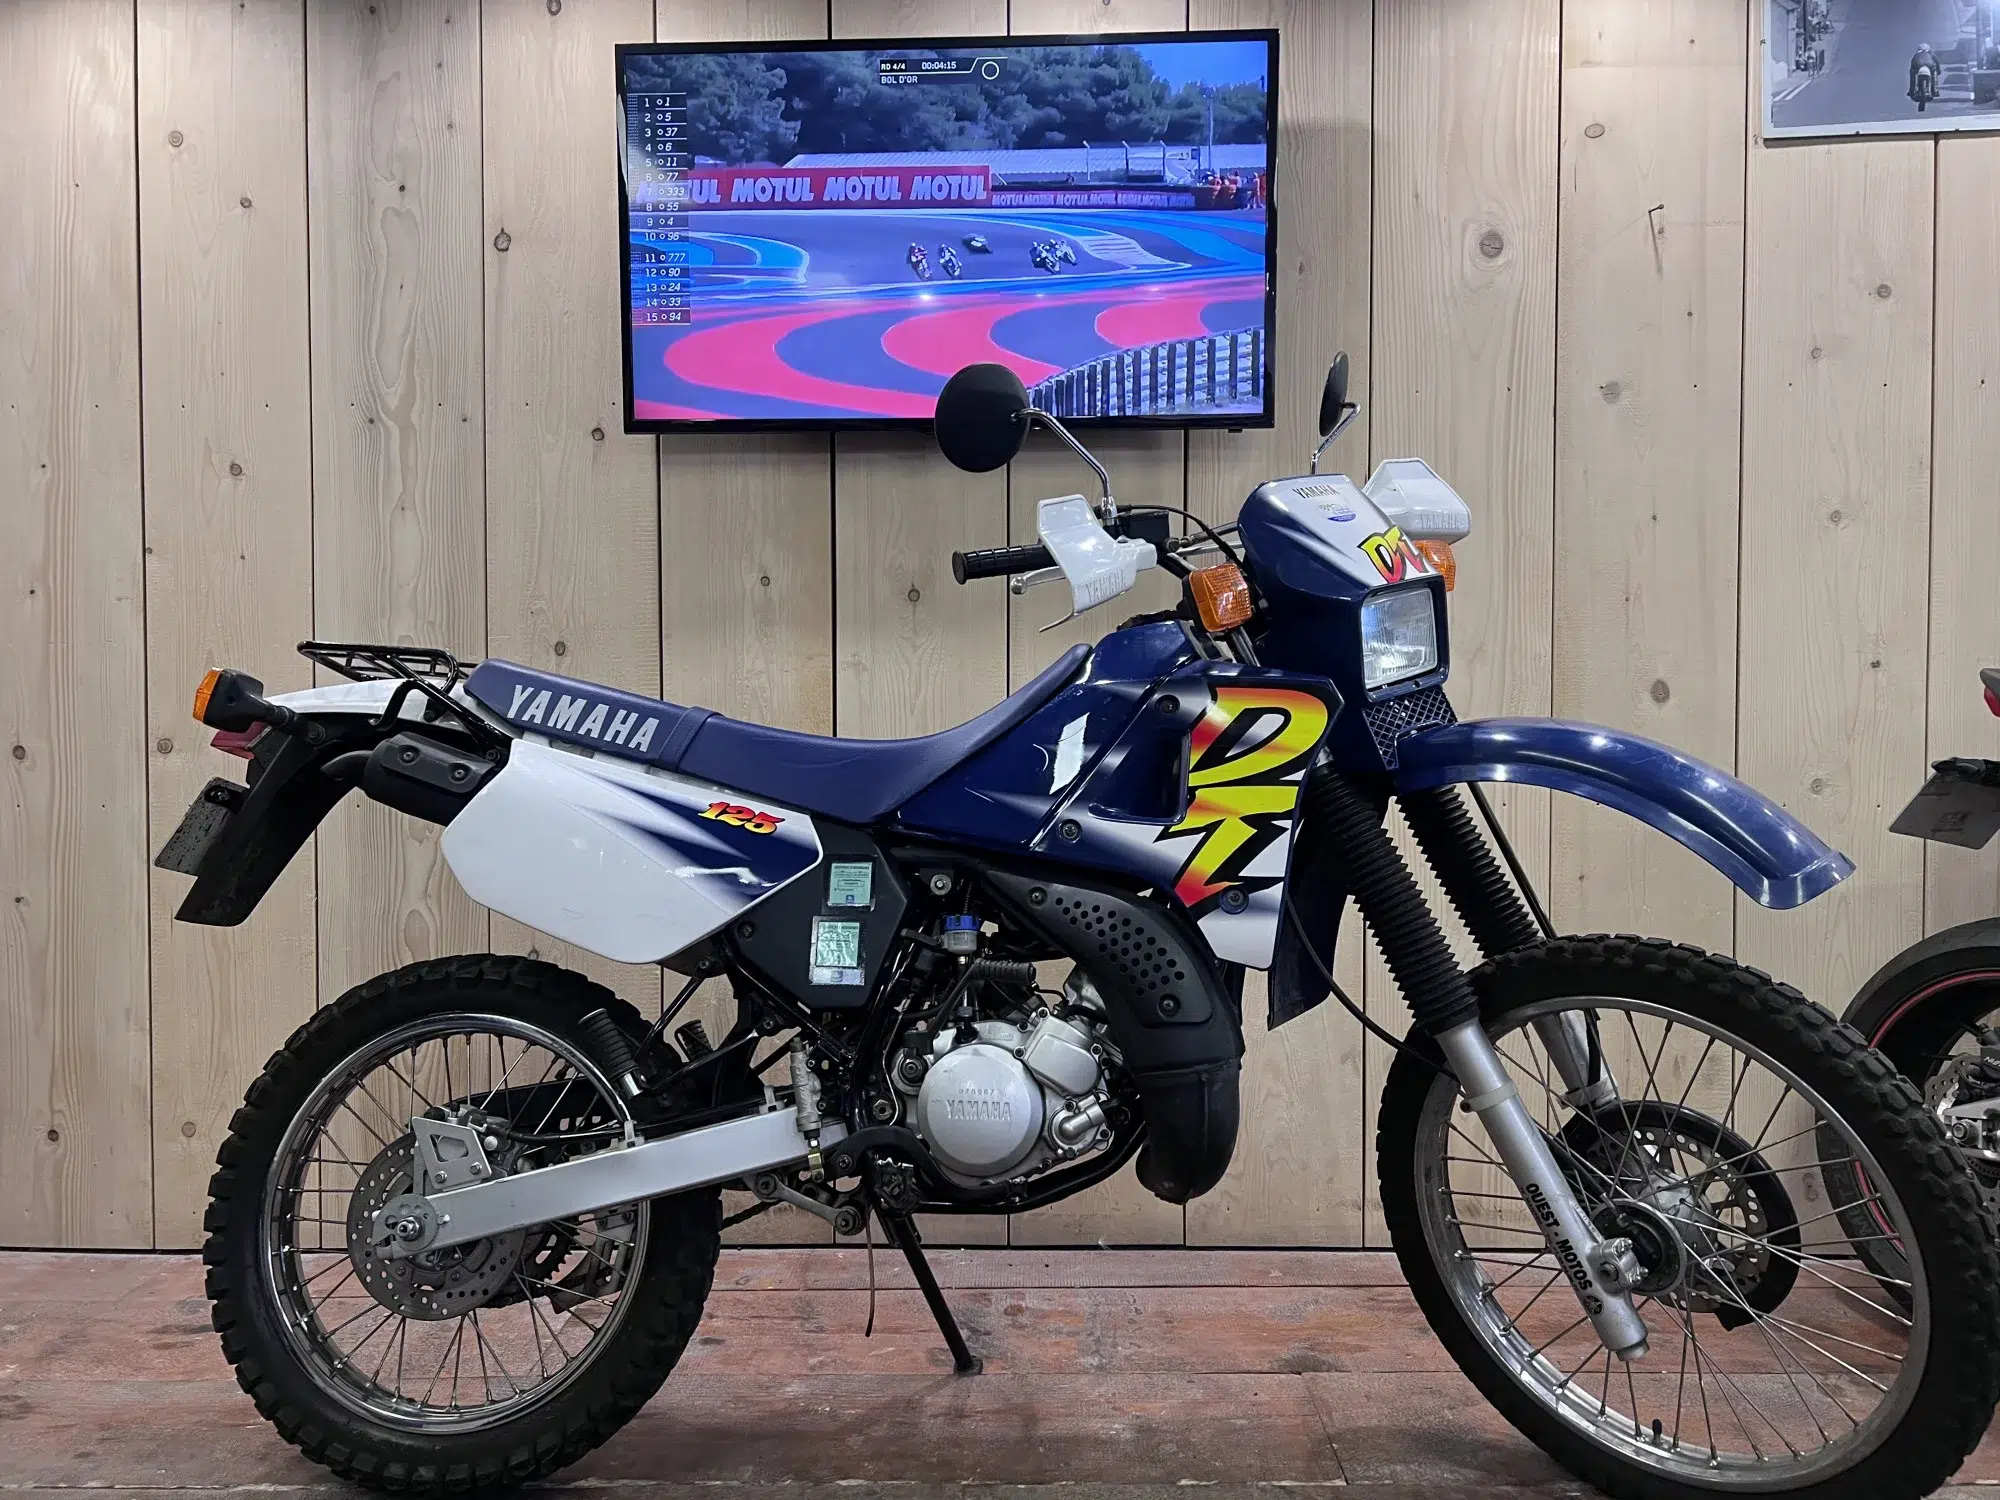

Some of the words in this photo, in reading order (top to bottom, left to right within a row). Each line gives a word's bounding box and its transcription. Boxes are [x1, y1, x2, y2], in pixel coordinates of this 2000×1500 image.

[892, 62, 906, 70] 4/4
[921, 61, 957, 70] 00:04:15
[881, 76, 899, 84] BOL
[899, 76, 918, 84] D'OR
[665, 128, 678, 136] 37
[666, 157, 677, 166] 11
[666, 172, 678, 181] 77
[667, 187, 685, 196] 333
[730, 177, 814, 202] MOTUL
[823, 176, 902, 202] MOTUL
[910, 174, 987, 200] MOTUL
[667, 202, 679, 211] 55
[645, 232, 656, 241] 10
[667, 232, 679, 240] 96
[645, 254, 656, 262] 11
[668, 253, 685, 262] 777
[646, 269, 656, 277] 12
[668, 268, 680, 276] 90
[646, 284, 657, 292] 13
[668, 283, 680, 291] 24
[646, 298, 657, 306] 14
[668, 298, 681, 306] 33
[646, 313, 658, 321] 15
[669, 312, 681, 321] 94
[1292, 484, 1340, 499] YAMAHA
[1420, 512, 1463, 531] YAMAHA
[506, 684, 660, 752] YAMAHA
[697, 800, 786, 835] 125
[946, 1100, 1012, 1120] YAMAHA
[1526, 1182, 1560, 1228] OUEST
[1556, 1238, 1592, 1290] MOTOS
